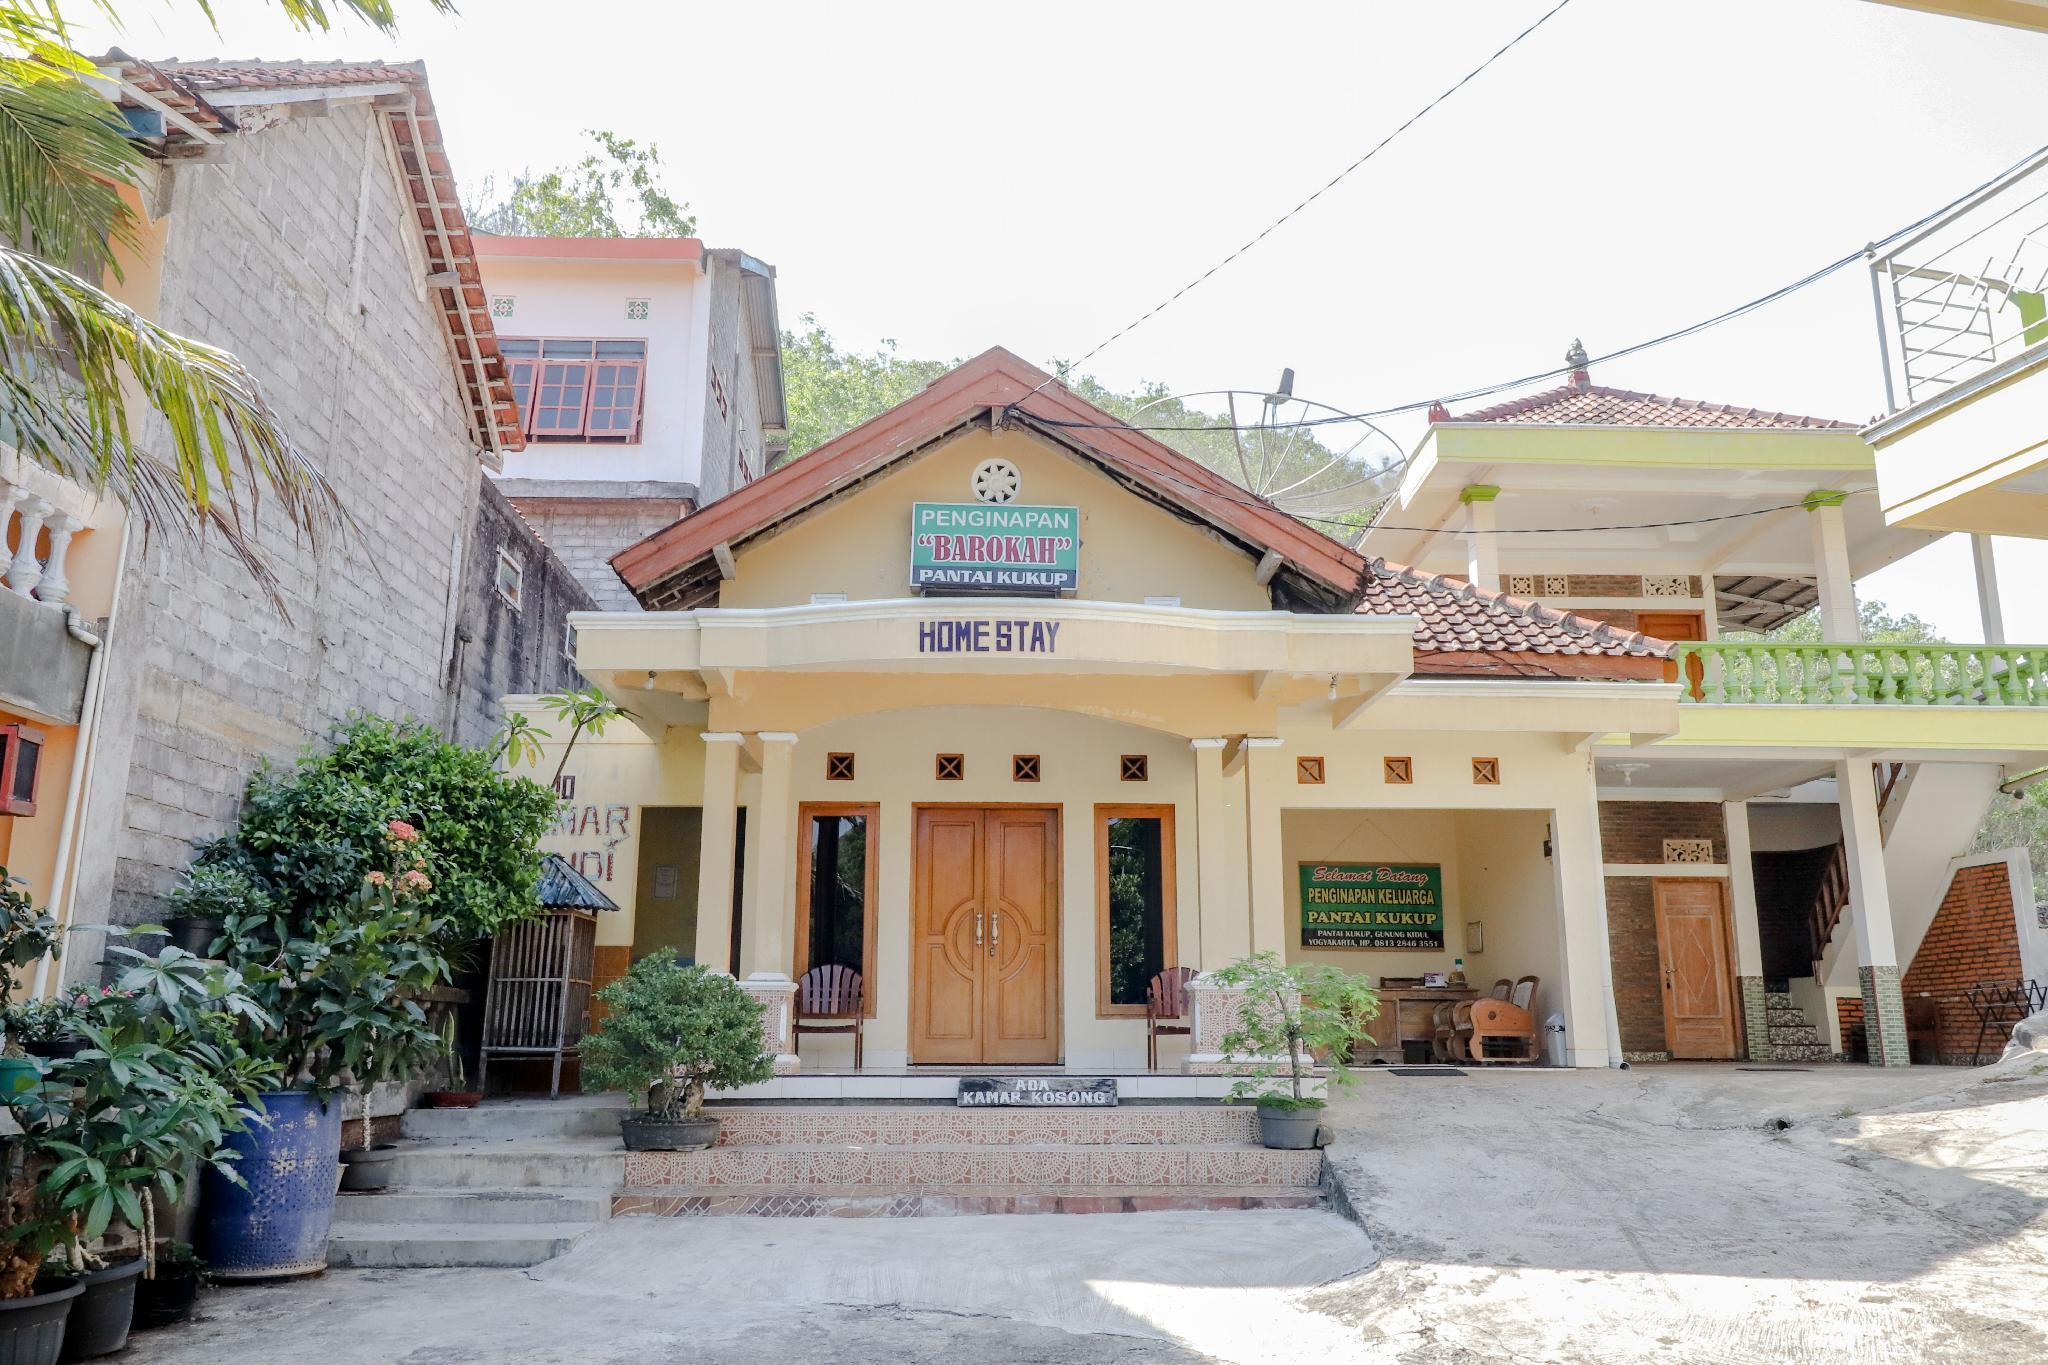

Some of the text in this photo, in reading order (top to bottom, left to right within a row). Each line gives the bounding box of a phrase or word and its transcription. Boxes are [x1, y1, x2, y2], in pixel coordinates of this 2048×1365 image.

[921, 509, 1069, 529] PENGINAPAN
[919, 569, 1068, 586] PANTAI KUKUP
[919, 620, 1060, 653] HOME STAY
[1312, 866, 1429, 887] Selamat Datang
[1308, 887, 1435, 905] PENGINAPAN KELUARGA
[1307, 911, 1437, 925] PANTAI KUKUP
[1374, 939, 1395, 947] 0813
[1015, 1079, 1050, 1091] ADA
[963, 1091, 1106, 1104] KAMAR KOSONG
